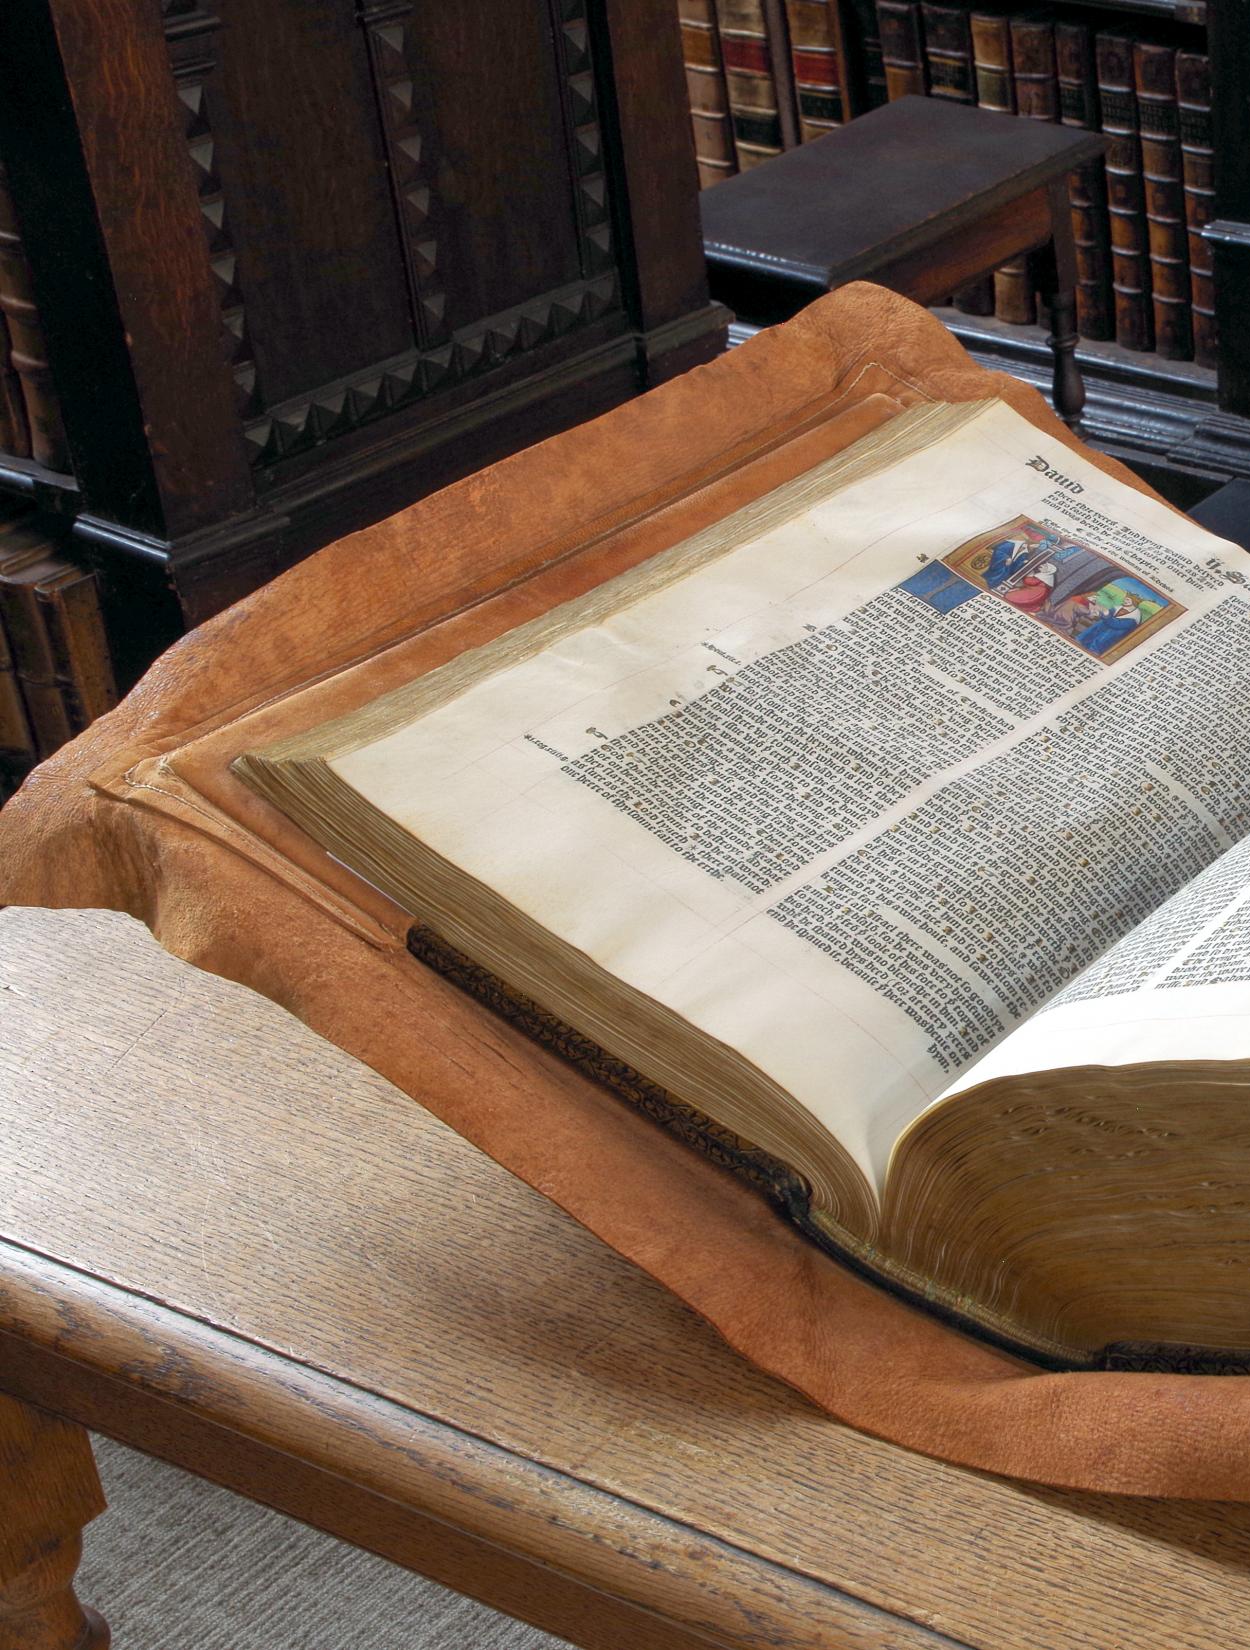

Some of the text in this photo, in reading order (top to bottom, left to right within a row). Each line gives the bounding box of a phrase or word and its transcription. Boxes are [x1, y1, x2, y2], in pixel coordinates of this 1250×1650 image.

[1006, 617, 1029, 632] that
[1027, 630, 1044, 640] the
[1009, 648, 1030, 660] and
[1010, 638, 1030, 651] and
[909, 666, 947, 690] woman
[1027, 678, 1046, 690] not
[1043, 687, 1062, 700] thy
[1032, 671, 1070, 694] and put
[965, 710, 986, 723] and
[984, 720, 1008, 737] done
[737, 786, 759, 800] and
[796, 822, 818, 838] and
[823, 805, 842, 818] the
[703, 819, 723, 831] the
[719, 828, 755, 851] bloude
[705, 809, 757, 841] remember
[823, 829, 846, 843] and
[670, 842, 684, 853] to
[680, 850, 700, 864] the
[690, 822, 704, 832] to
[758, 866, 786, 883] that
[696, 850, 725, 867] there
[743, 880, 765, 895] not
